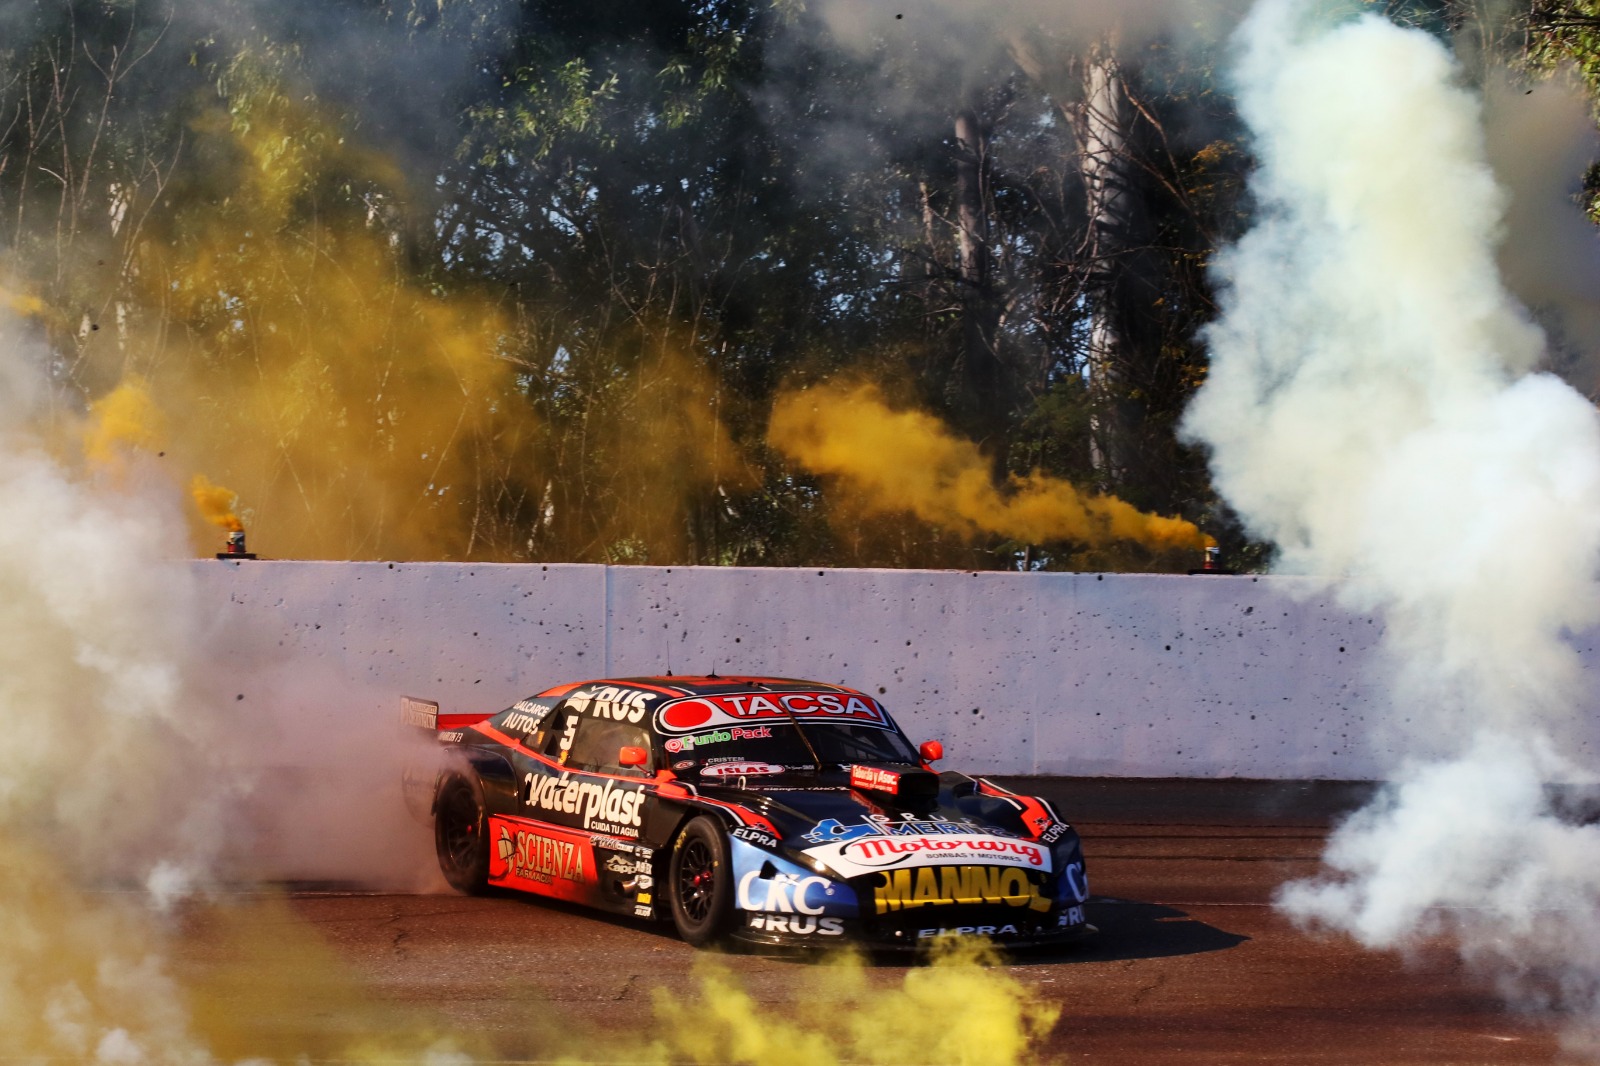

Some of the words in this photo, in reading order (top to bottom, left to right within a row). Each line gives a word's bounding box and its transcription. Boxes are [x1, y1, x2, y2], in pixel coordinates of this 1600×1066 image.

[513, 700, 550, 717] BALCARCE
[592, 686, 657, 724] RUS
[723, 694, 878, 719] TACSA
[501, 712, 541, 735] AUTOS
[717, 766, 770, 775] ISLAS
[524, 771, 646, 829] waterplast
[590, 820, 611, 833] CUIDA
[610, 824, 621, 835] TU
[620, 826, 639, 838] AGUA
[732, 828, 778, 848] ELPRA
[1042, 822, 1070, 844] ELPRA
[516, 830, 586, 882] SCIENZA
[851, 837, 1044, 866] Motorarg
[976, 853, 1023, 863] MOTORES
[515, 867, 553, 884] FARMACIA
[738, 870, 832, 916] CKC
[874, 866, 1053, 915] MANNOL
[766, 914, 845, 936] RUS
[918, 924, 1019, 939] ELPRA
